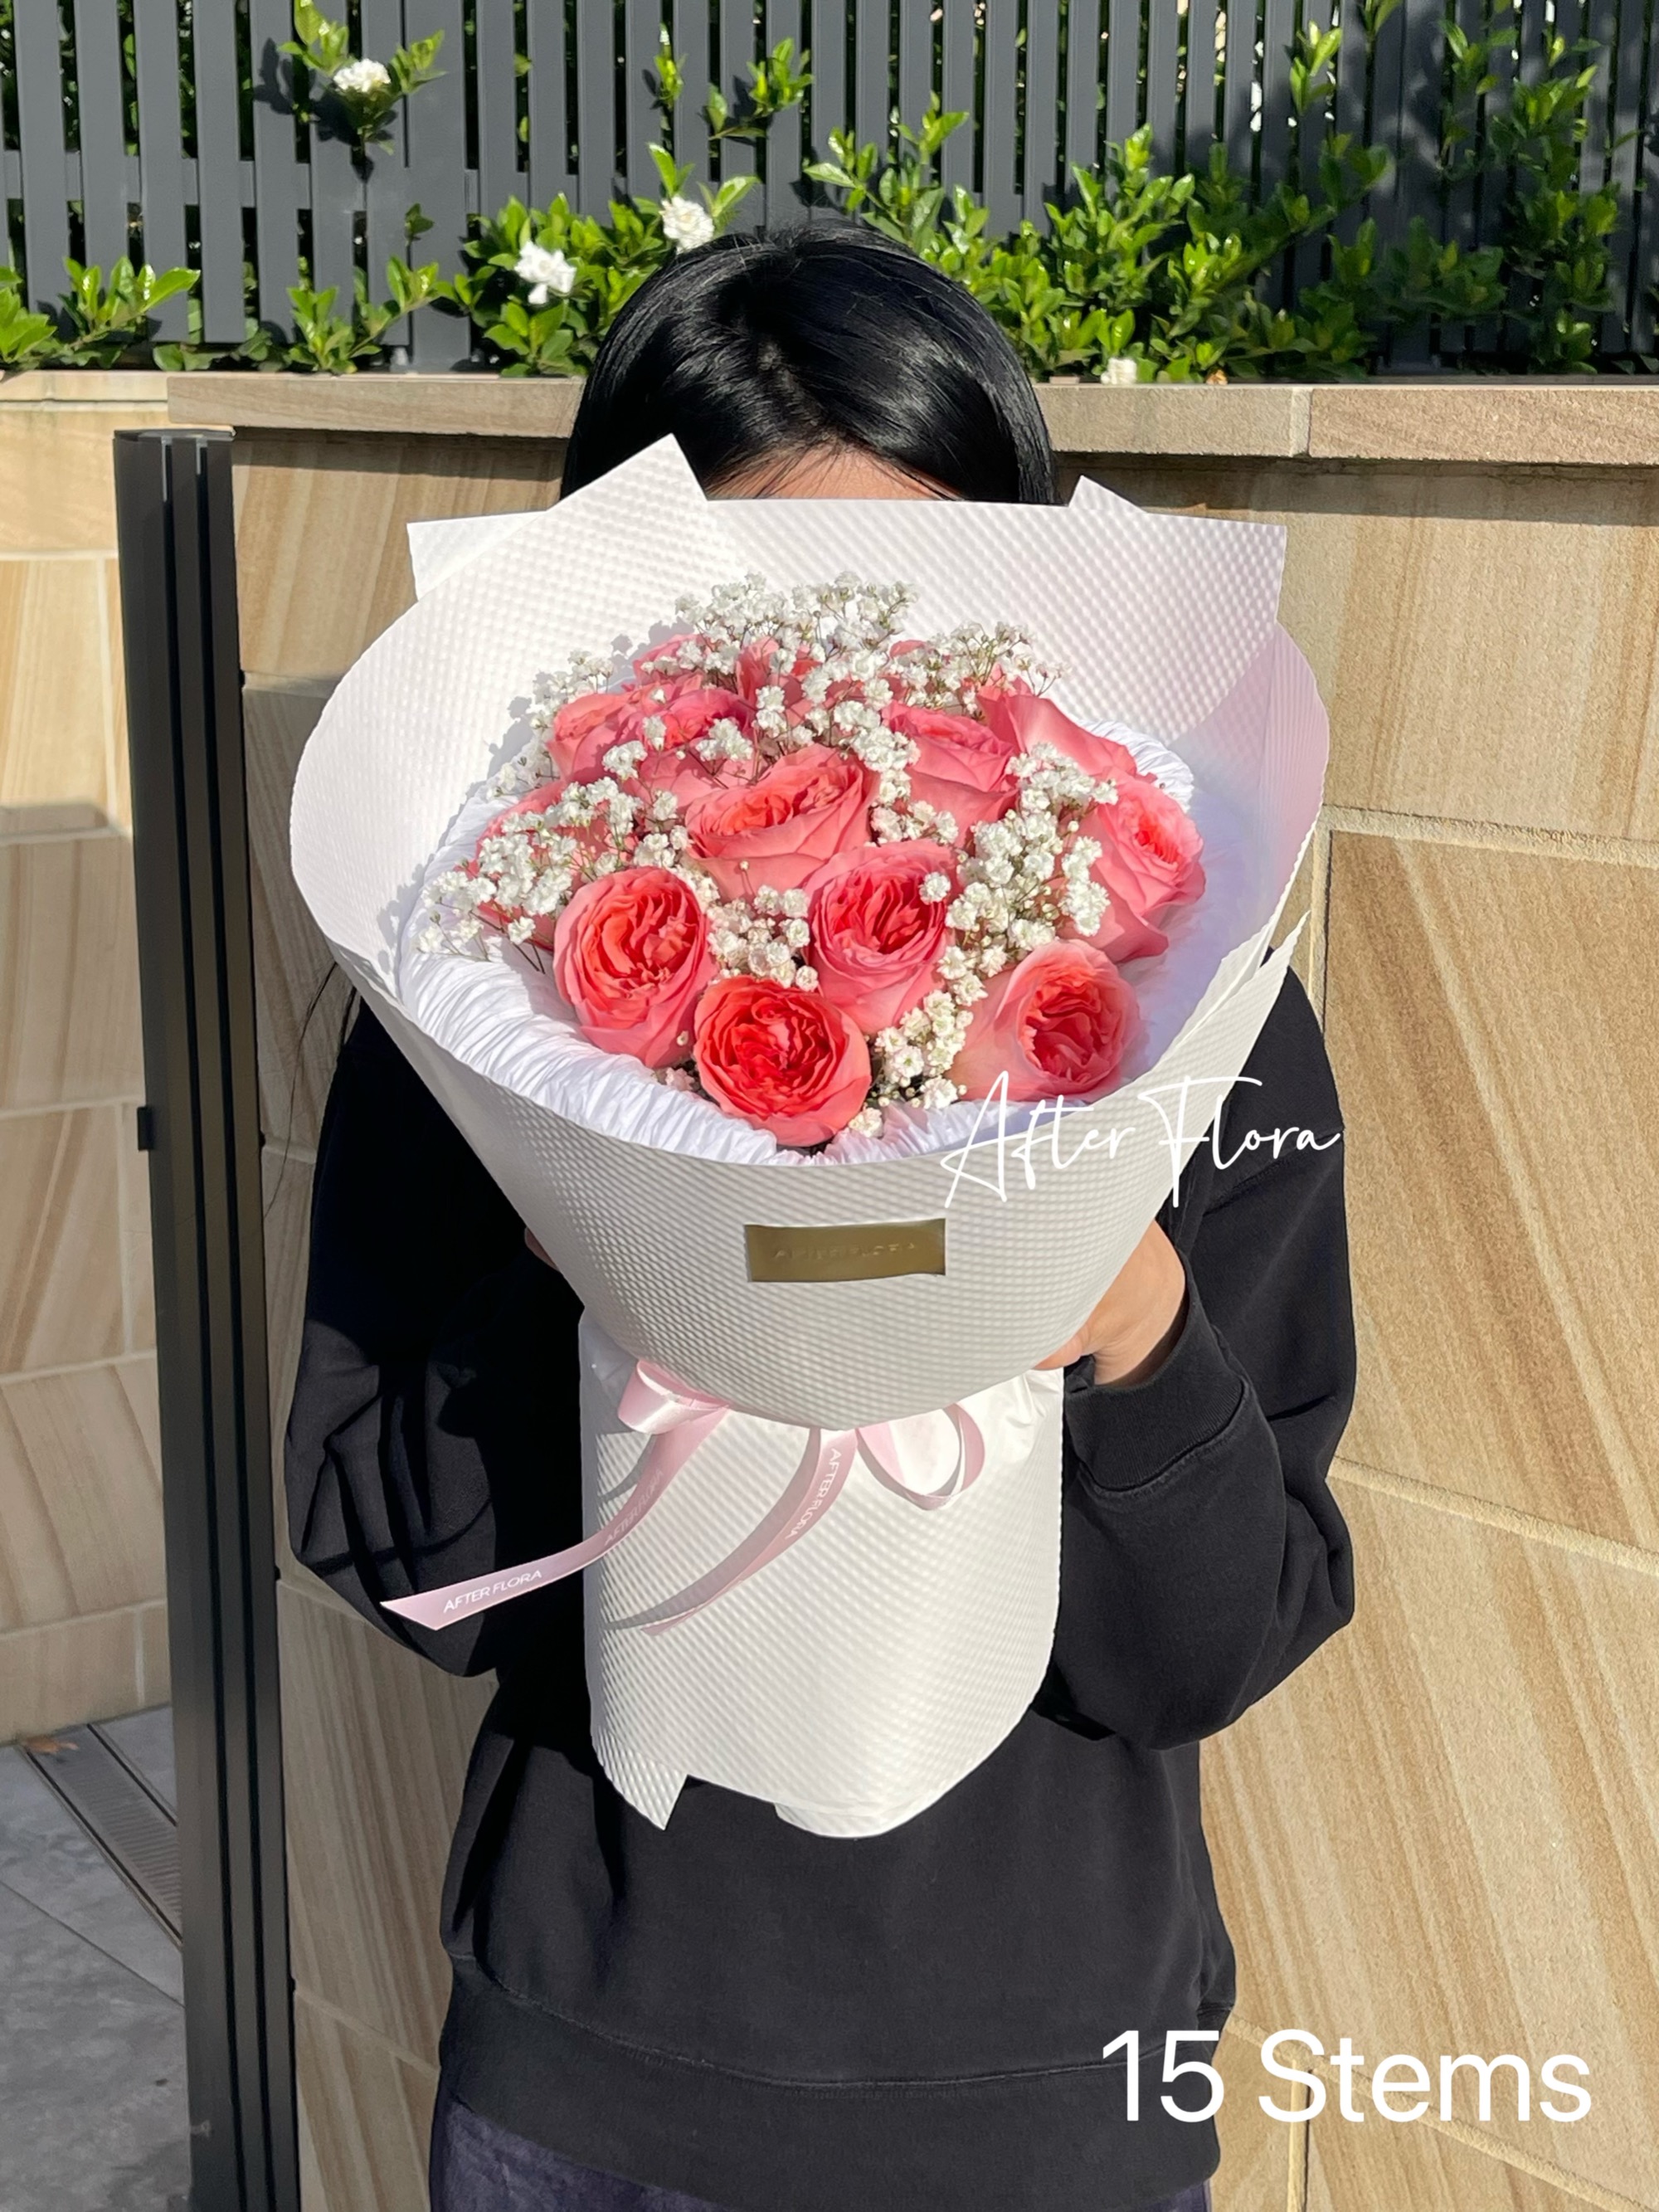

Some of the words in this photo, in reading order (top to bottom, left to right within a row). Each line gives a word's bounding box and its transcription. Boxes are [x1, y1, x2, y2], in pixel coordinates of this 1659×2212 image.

[816, 1448, 842, 1498] AFTER
[785, 1499, 823, 1539] FLORA
[443, 1586, 490, 1614] AFTER
[493, 1570, 542, 1594] FLORA
